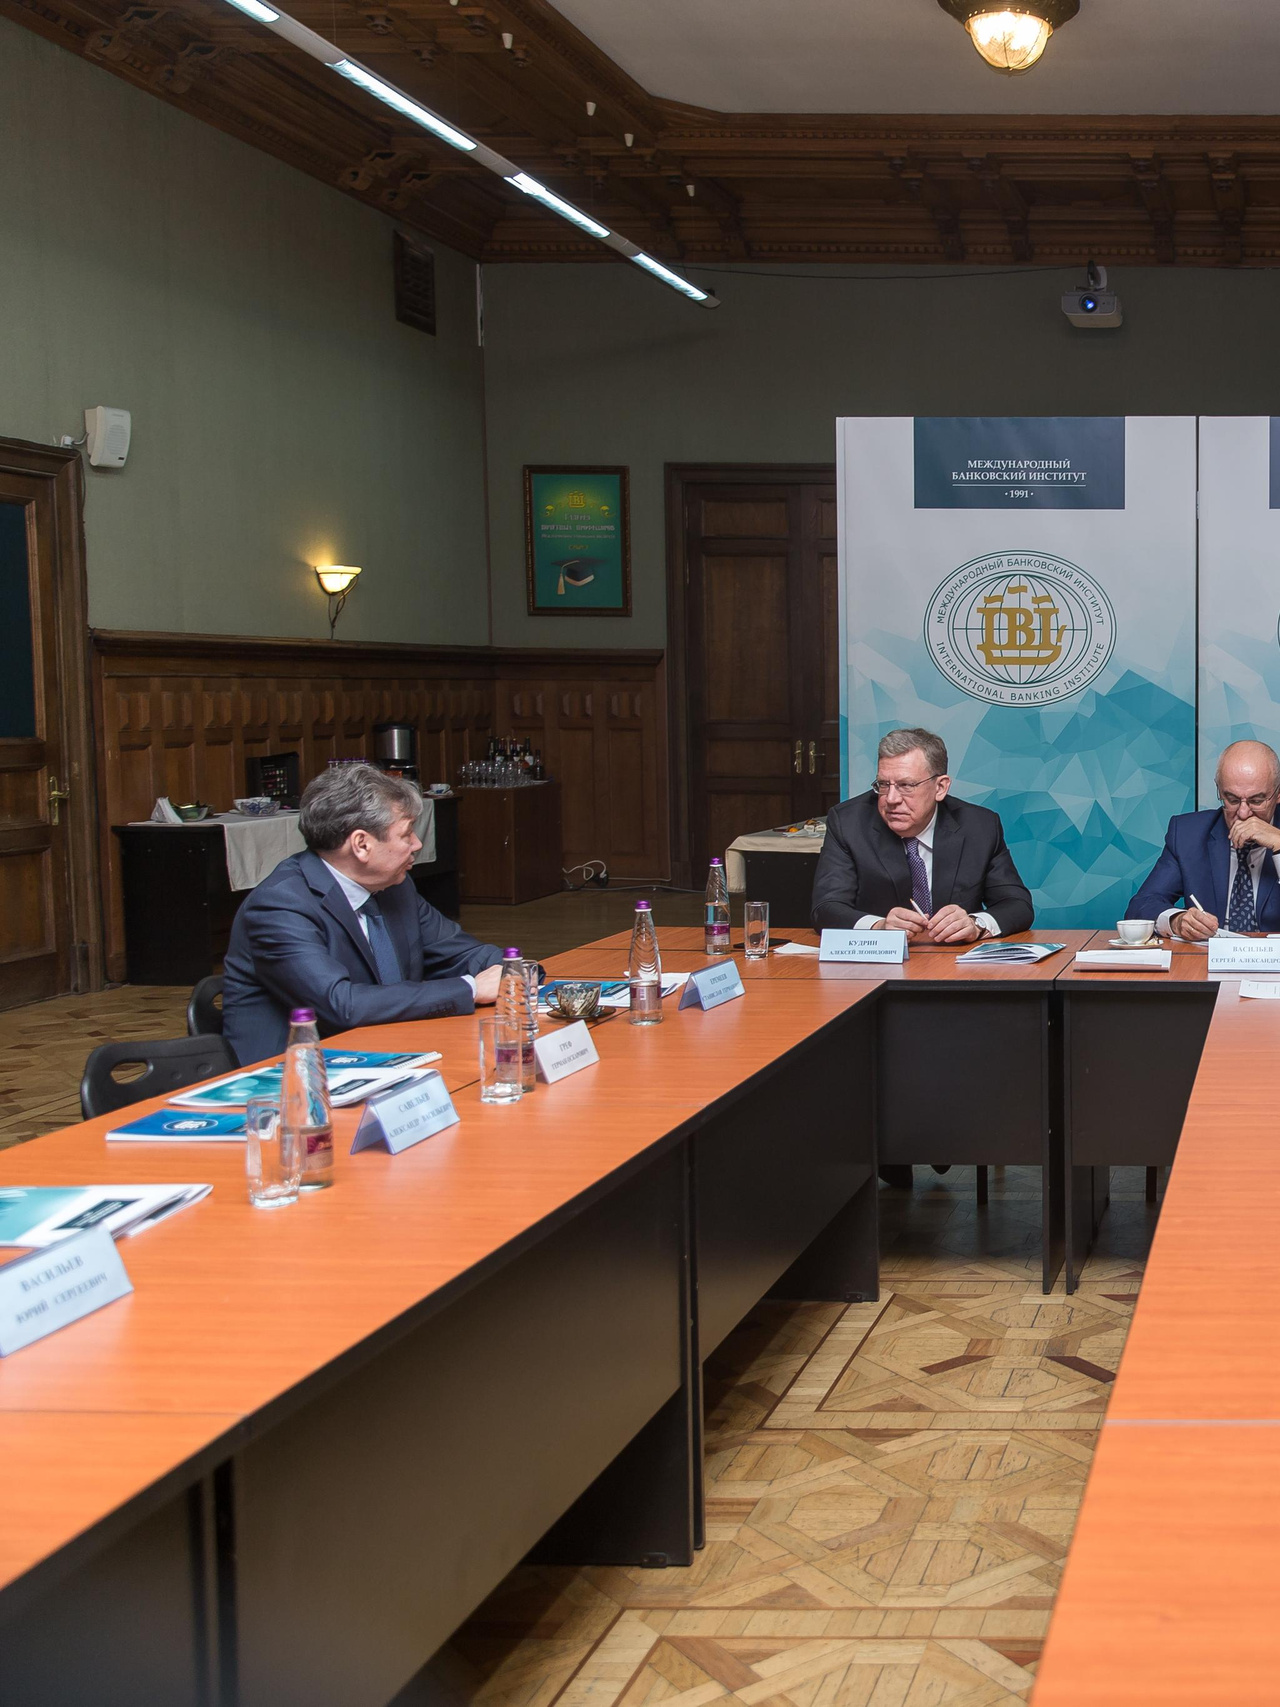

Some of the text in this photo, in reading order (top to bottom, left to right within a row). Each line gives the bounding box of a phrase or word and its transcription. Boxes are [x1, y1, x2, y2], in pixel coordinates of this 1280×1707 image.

[951, 469, 1087, 482] БАНКОВСКИЙ ИНСТИТУТ
[967, 458, 1071, 470] МЕЖДУНАРОДНЫЙ
[936, 557, 1104, 626] МЕЖДУНАРОДНЫЙ БАНКОВСКИЙ ИНСТИТУТ
[936, 641, 1105, 702] INTERNATIONAL BANKING INSTITUTE
[559, 1041, 573, 1052] ГРЕФ
[389, 1102, 453, 1138] АЛЕКСАНДР ВАСИЛЬЕВИЧ
[398, 1092, 431, 1113] САВЕЛЬЕВ
[20, 1255, 84, 1292] ВАСИЛЬЕВ
[15, 1272, 108, 1324] ЮРИЙ СЕРГЕЕВИЧ
